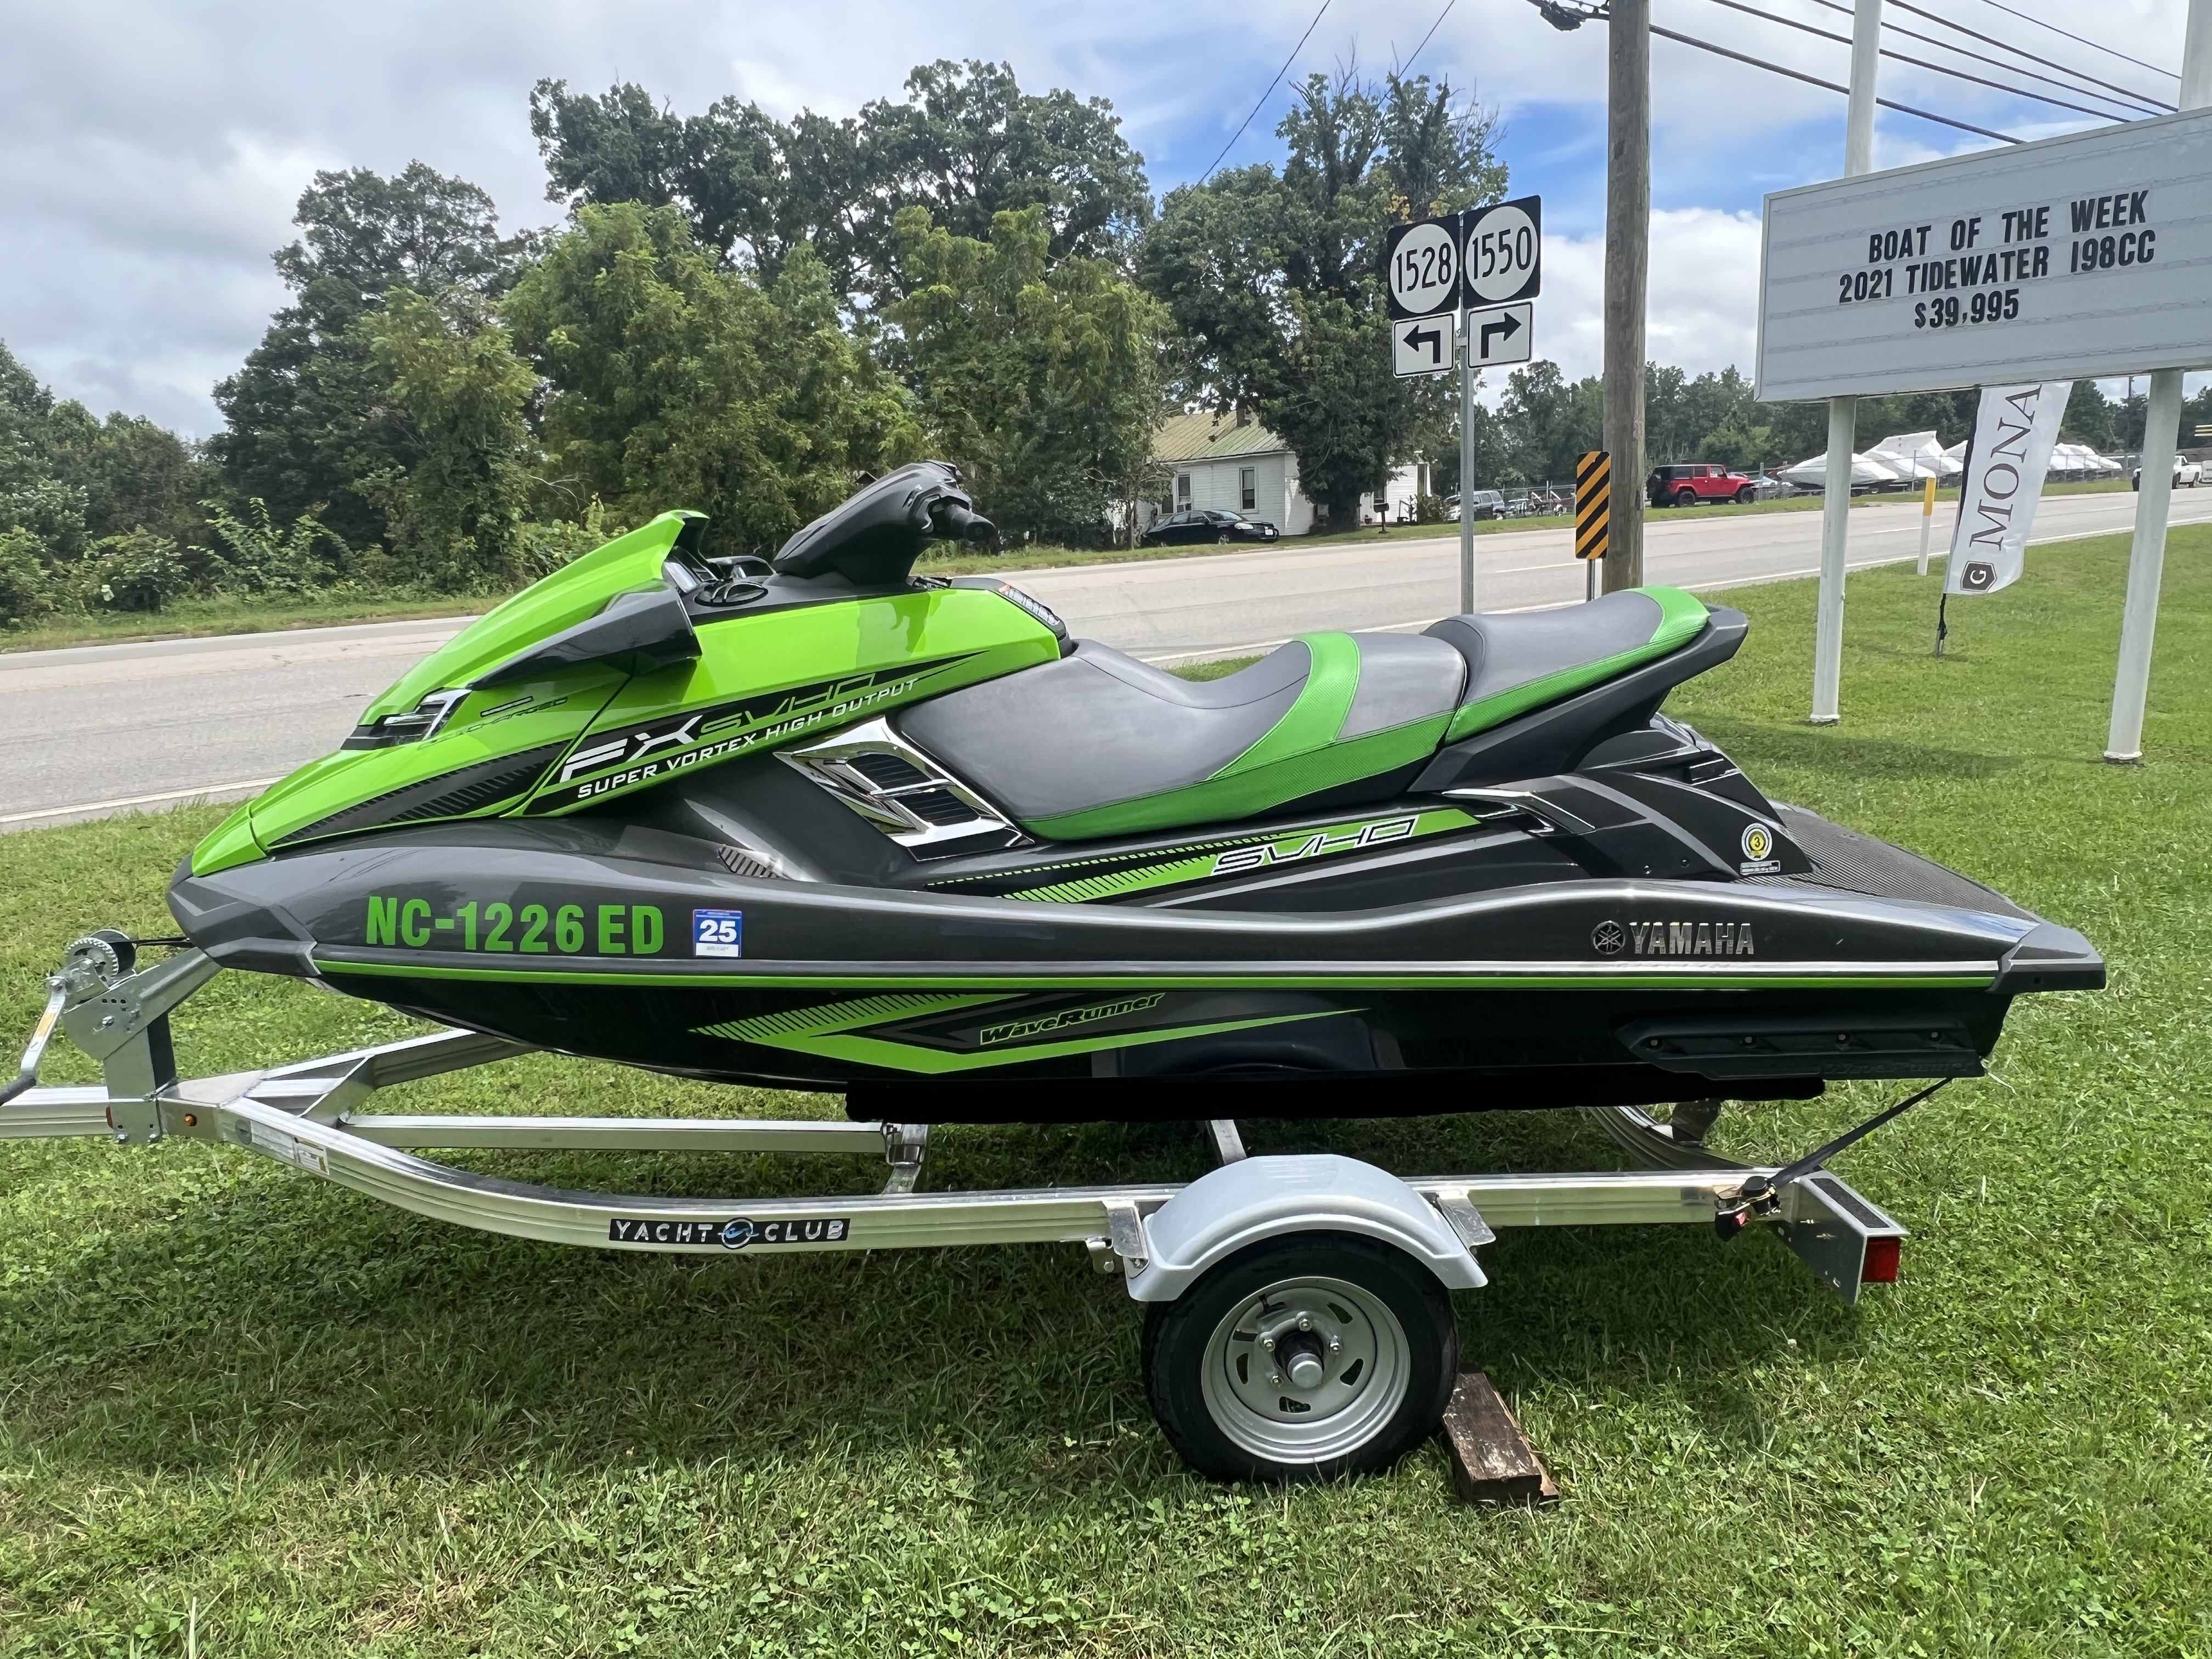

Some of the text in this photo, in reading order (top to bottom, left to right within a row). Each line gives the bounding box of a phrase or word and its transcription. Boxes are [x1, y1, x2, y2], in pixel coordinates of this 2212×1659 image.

[1472, 225, 1532, 280] 1550
[1869, 189, 2149, 263] BOAT OF THE WEEK
[1396, 242, 1452, 294] 1528
[1839, 269, 1893, 304] 2021
[1905, 246, 2049, 294] TIDEWATER
[1914, 288, 2019, 329] $39,995
[559, 714, 703, 783] FX
[577, 678, 919, 798] SUPER VORTEX HIGH OUTPUT
[1209, 814, 1420, 877] SVHO
[1754, 836, 1761, 848] 3
[366, 896, 664, 954] NC-1226 ED
[699, 919, 737, 943] 25
[1629, 922, 1754, 955] YAMAHA
[980, 992, 1166, 1046] WaveRunner
[616, 1220, 844, 1242] YACHT CLUB
